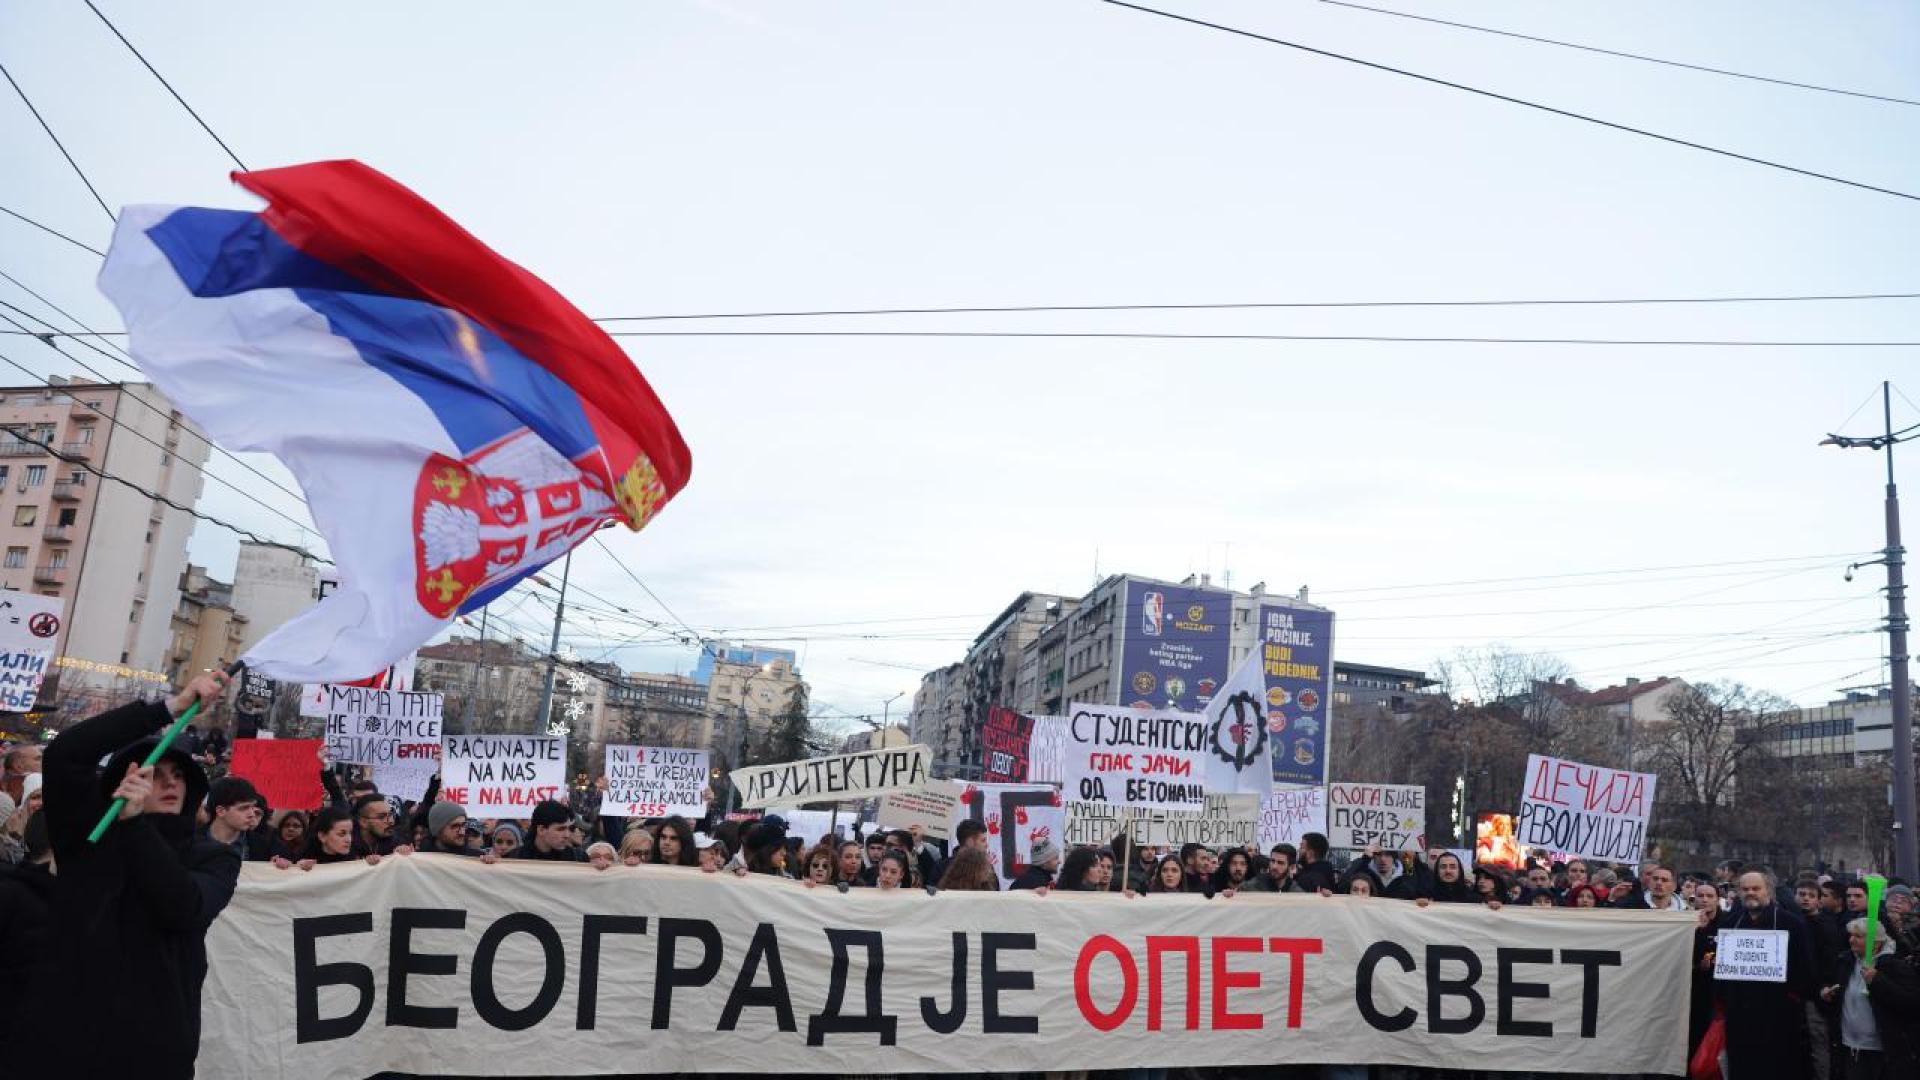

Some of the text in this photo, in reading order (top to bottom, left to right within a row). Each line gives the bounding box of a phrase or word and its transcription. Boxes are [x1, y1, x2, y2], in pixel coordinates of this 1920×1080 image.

[1176, 621, 1216, 632] MOZZART
[1267, 612, 1293, 629] IGRA
[1265, 645, 1291, 660] BUDI
[331, 687, 444, 717] МАМА ТАТА
[327, 714, 347, 734] НЕ
[417, 720, 438, 737] СЕ
[1071, 711, 1208, 752] СТУДЕНТСКИ
[448, 737, 560, 760] RAČUNAJTE
[612, 750, 700, 766] NI 1 ŽIVOT
[468, 761, 536, 783] NA NAS
[612, 765, 705, 780] NIJE VREDAN
[1090, 752, 1191, 777] ГЛАС ЈАЧИ
[610, 780, 666, 790] OPSTANKA
[747, 752, 926, 802] АРХИТЕКТУРА
[1529, 760, 1645, 816] ДЕЧИЈА
[446, 787, 559, 804] NE NA VLAST
[1080, 776, 1203, 804] ОД БЕТОНА!!!
[1332, 786, 1422, 809] СЛОГА БИЋЕ
[627, 804, 667, 816] 1555
[1335, 808, 1400, 830] ПОРАЗ
[1352, 830, 1410, 849] ВРАГУ
[1518, 802, 1644, 860] РЕВОЛУЦИЈА
[1736, 938, 1754, 948] UVEK
[1734, 951, 1768, 962] STUDENTE
[293, 907, 1622, 1047] БЕОГРАД ЈЕ ОПЕТ СВЕТ
[1716, 964, 1738, 974] ZORAN
